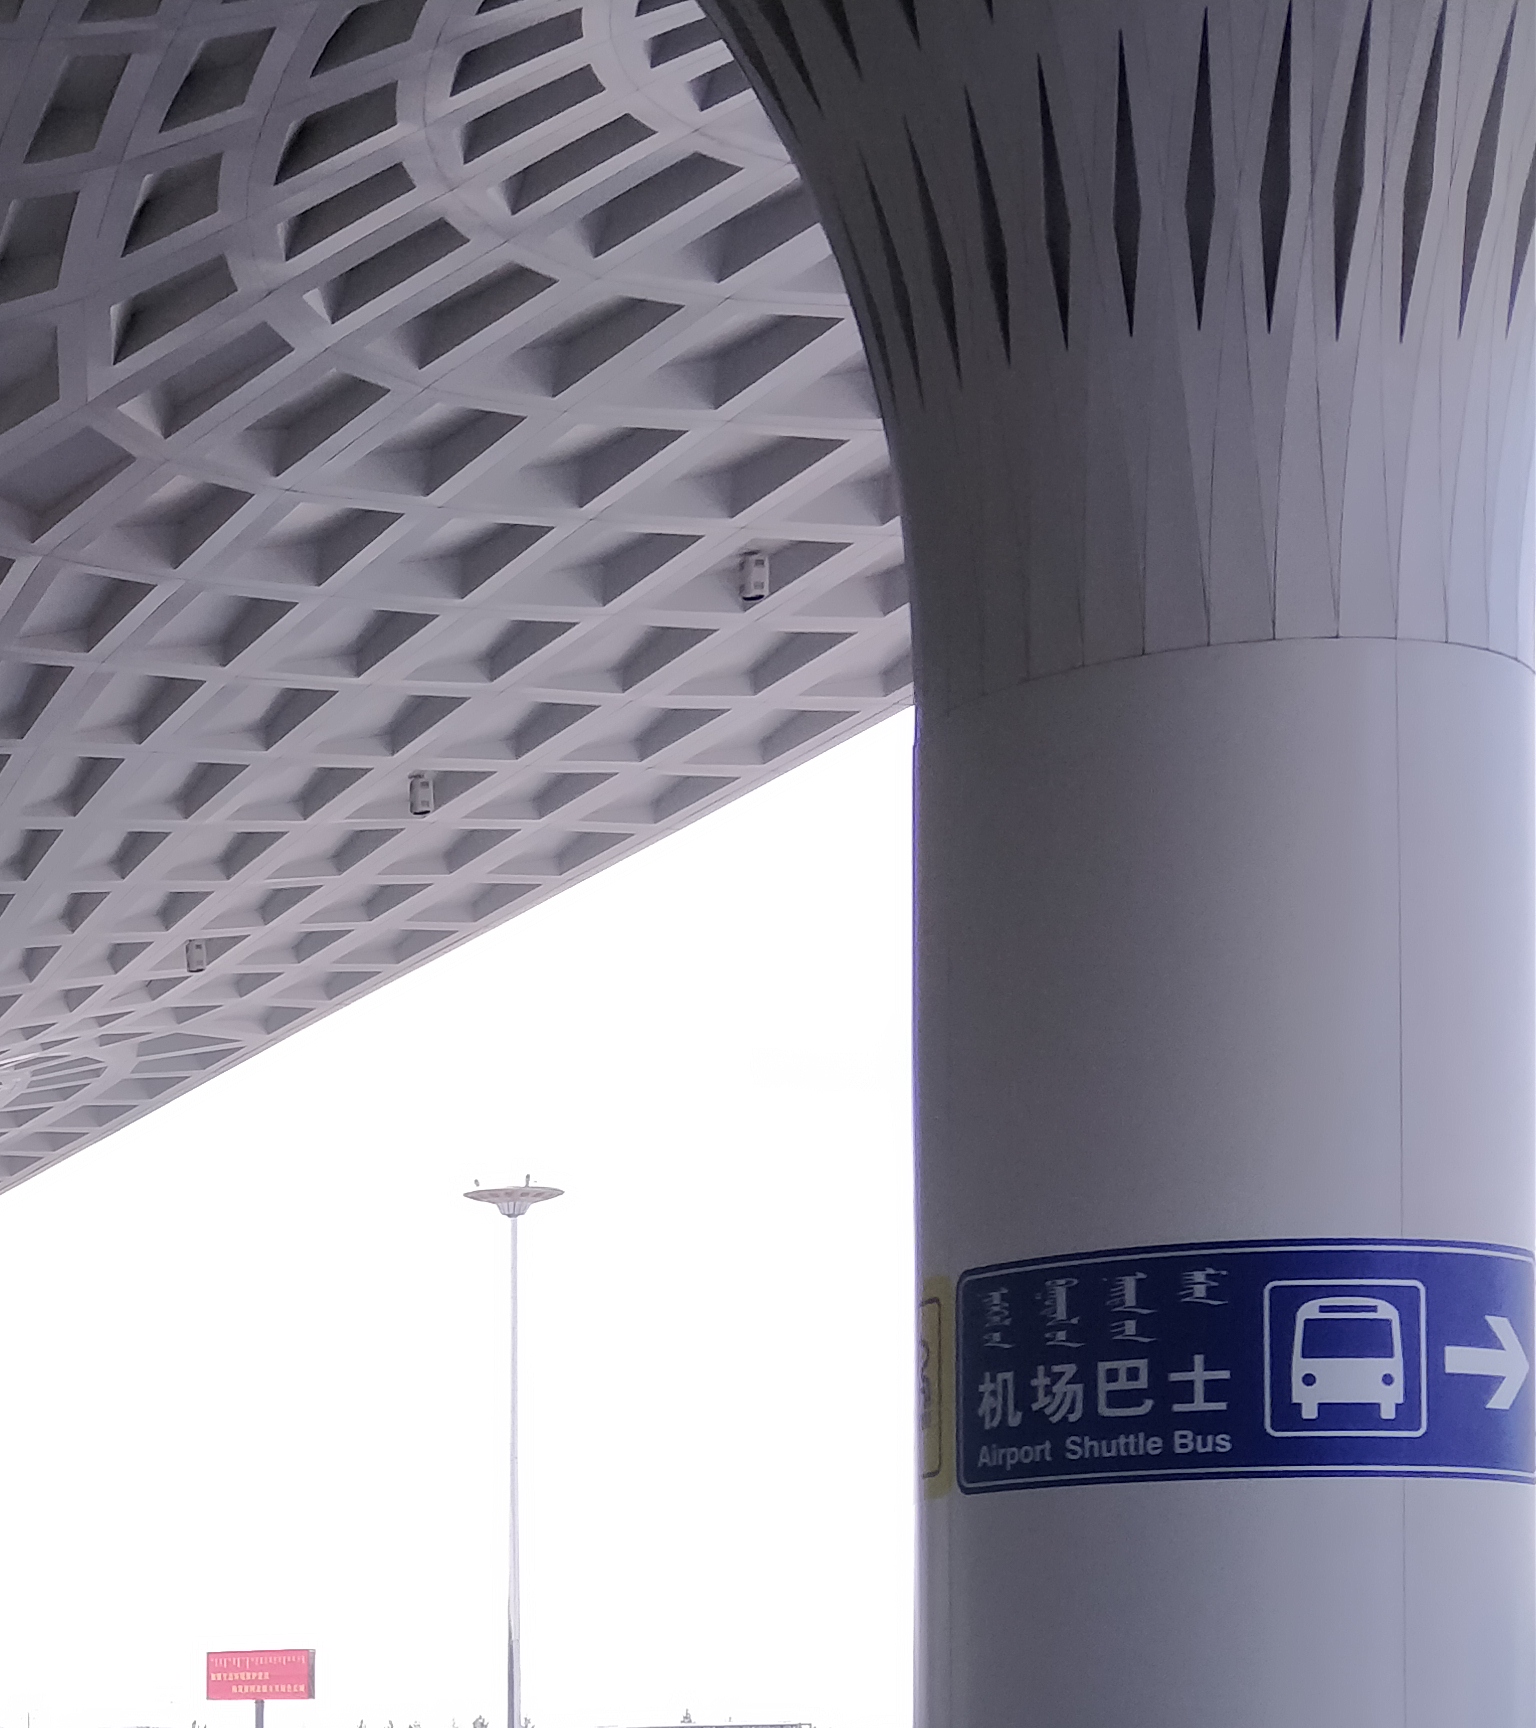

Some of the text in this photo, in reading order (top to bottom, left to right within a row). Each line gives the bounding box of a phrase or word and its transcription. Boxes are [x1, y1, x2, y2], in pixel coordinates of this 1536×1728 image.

[977, 1353, 1231, 1430] 机场巴士
[977, 1429, 1233, 1471] Airport Shuttle Bus
